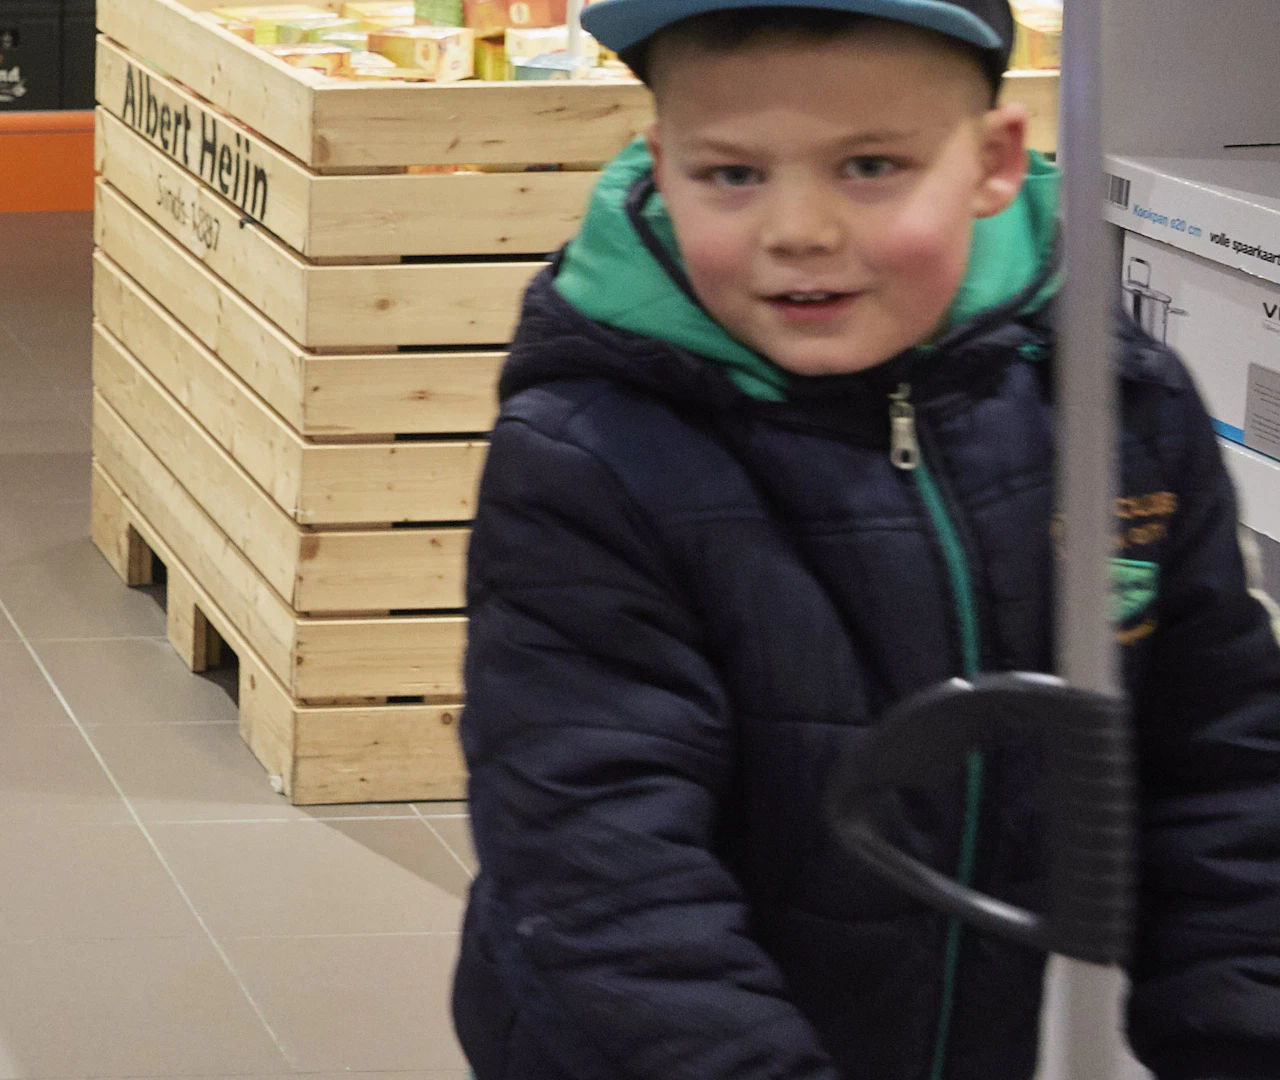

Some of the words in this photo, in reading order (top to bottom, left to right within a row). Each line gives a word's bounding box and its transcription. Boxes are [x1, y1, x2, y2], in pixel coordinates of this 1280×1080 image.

[122, 61, 191, 166] Albert
[200, 111, 269, 228] Heijn
[1133, 202, 1169, 227] Kookpan
[1187, 225, 1202, 238] cm
[1209, 231, 1231, 248] volle
